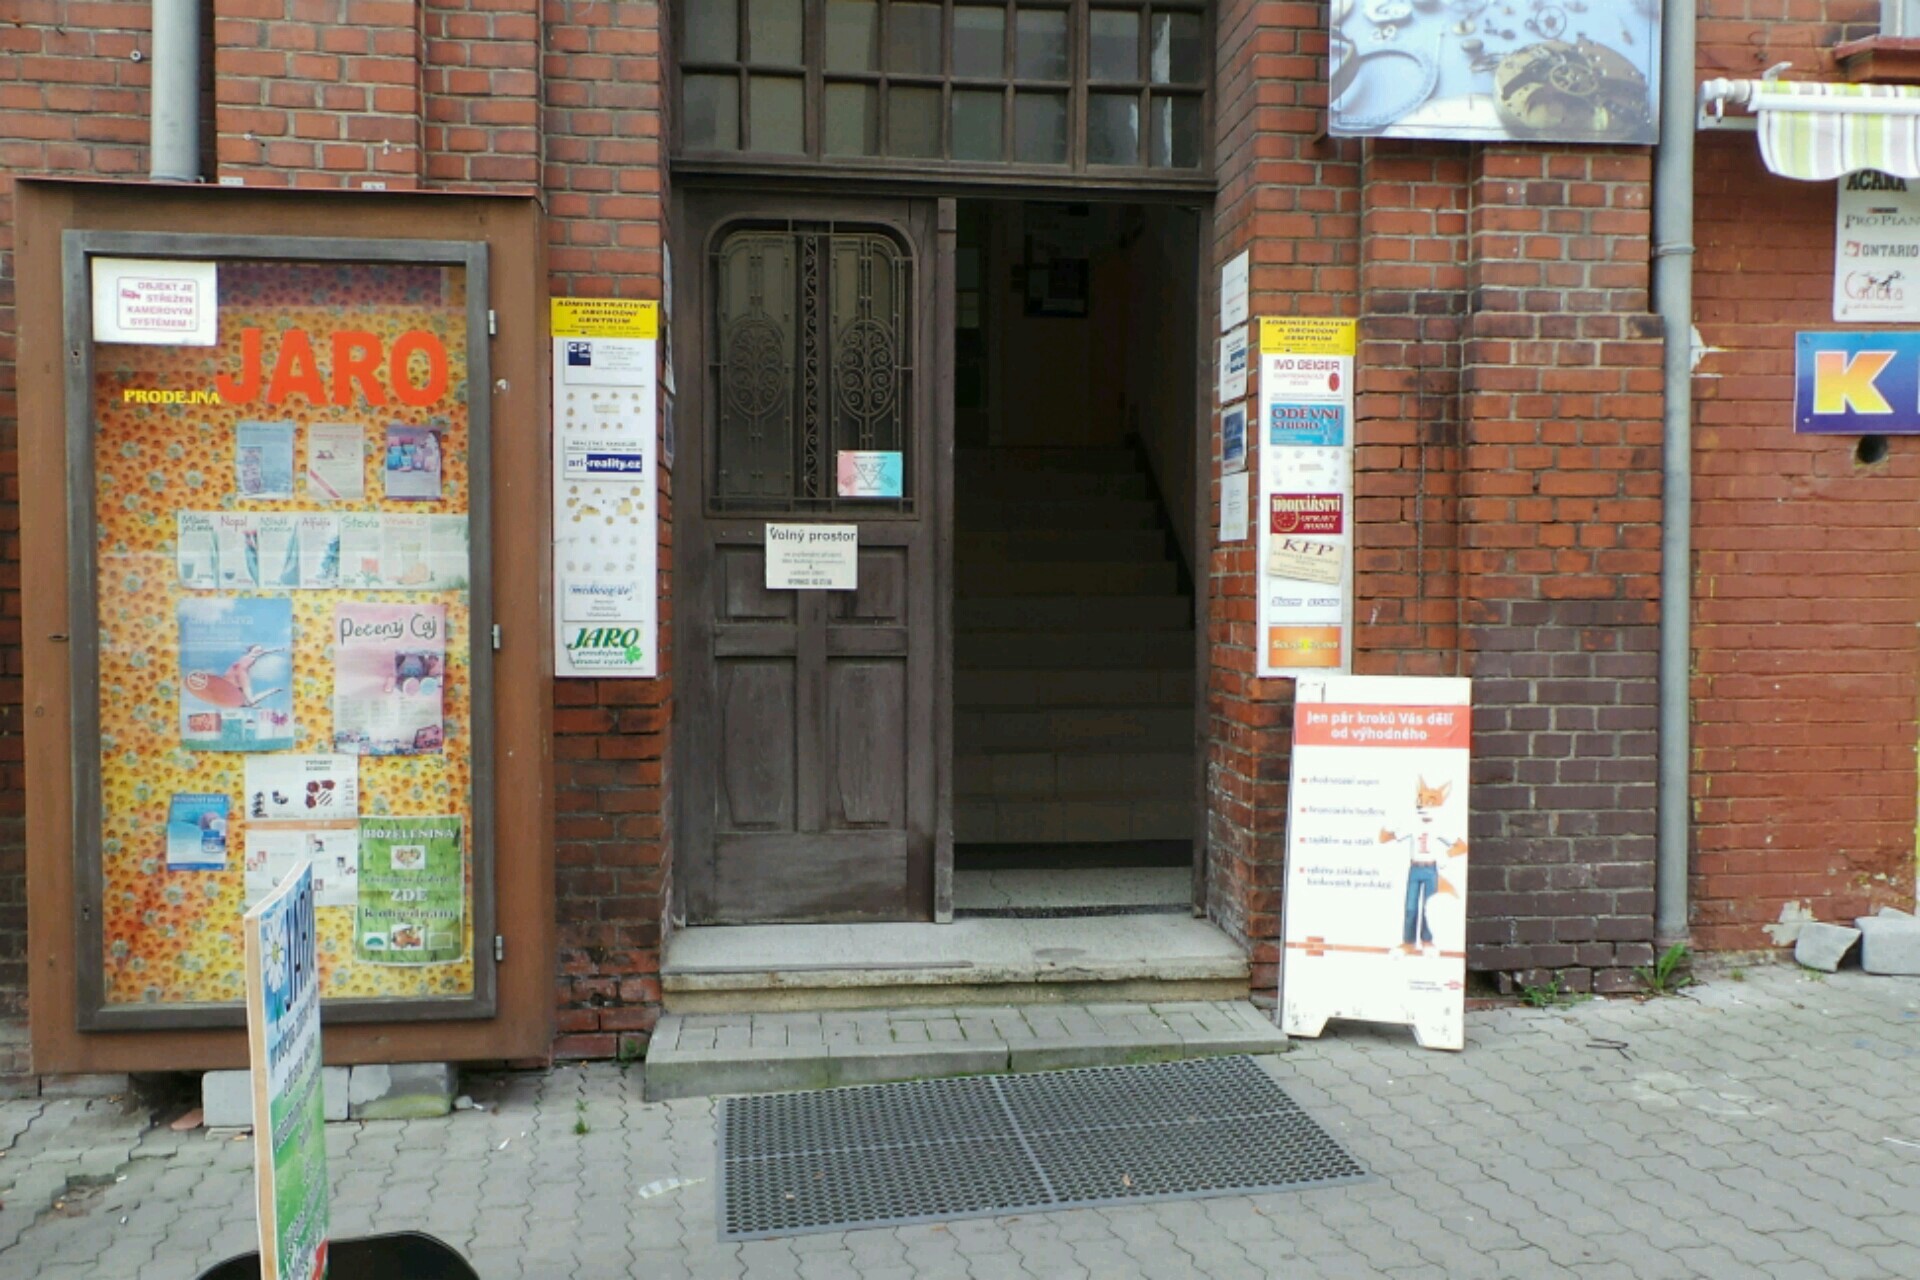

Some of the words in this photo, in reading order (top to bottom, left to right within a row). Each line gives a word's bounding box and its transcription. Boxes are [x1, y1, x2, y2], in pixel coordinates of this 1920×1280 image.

[1846, 215, 1878, 227] PRO
[1862, 244, 1918, 257] ONTARIO
[138, 282, 178, 291] OBJEKT
[180, 284, 193, 292] JE
[568, 342, 592, 353] CPI
[216, 327, 448, 406] JARO
[1273, 359, 1295, 370] IVO
[1297, 360, 1340, 371] GEIGER
[123, 389, 221, 406] PRODEJNA
[220, 515, 248, 529] Nopal
[770, 527, 805, 543] Volný
[808, 529, 857, 543] prostor
[339, 617, 404, 646] Pečený
[410, 612, 437, 640] Čaj
[567, 627, 640, 650] JARO
[1307, 711, 1327, 725] Jen
[1331, 711, 1354, 727] pár
[1357, 711, 1395, 724] kroků
[1398, 711, 1423, 724] Vás
[1427, 712, 1454, 726] dělí
[1331, 727, 1348, 738] od
[1352, 728, 1428, 742] výhodného
